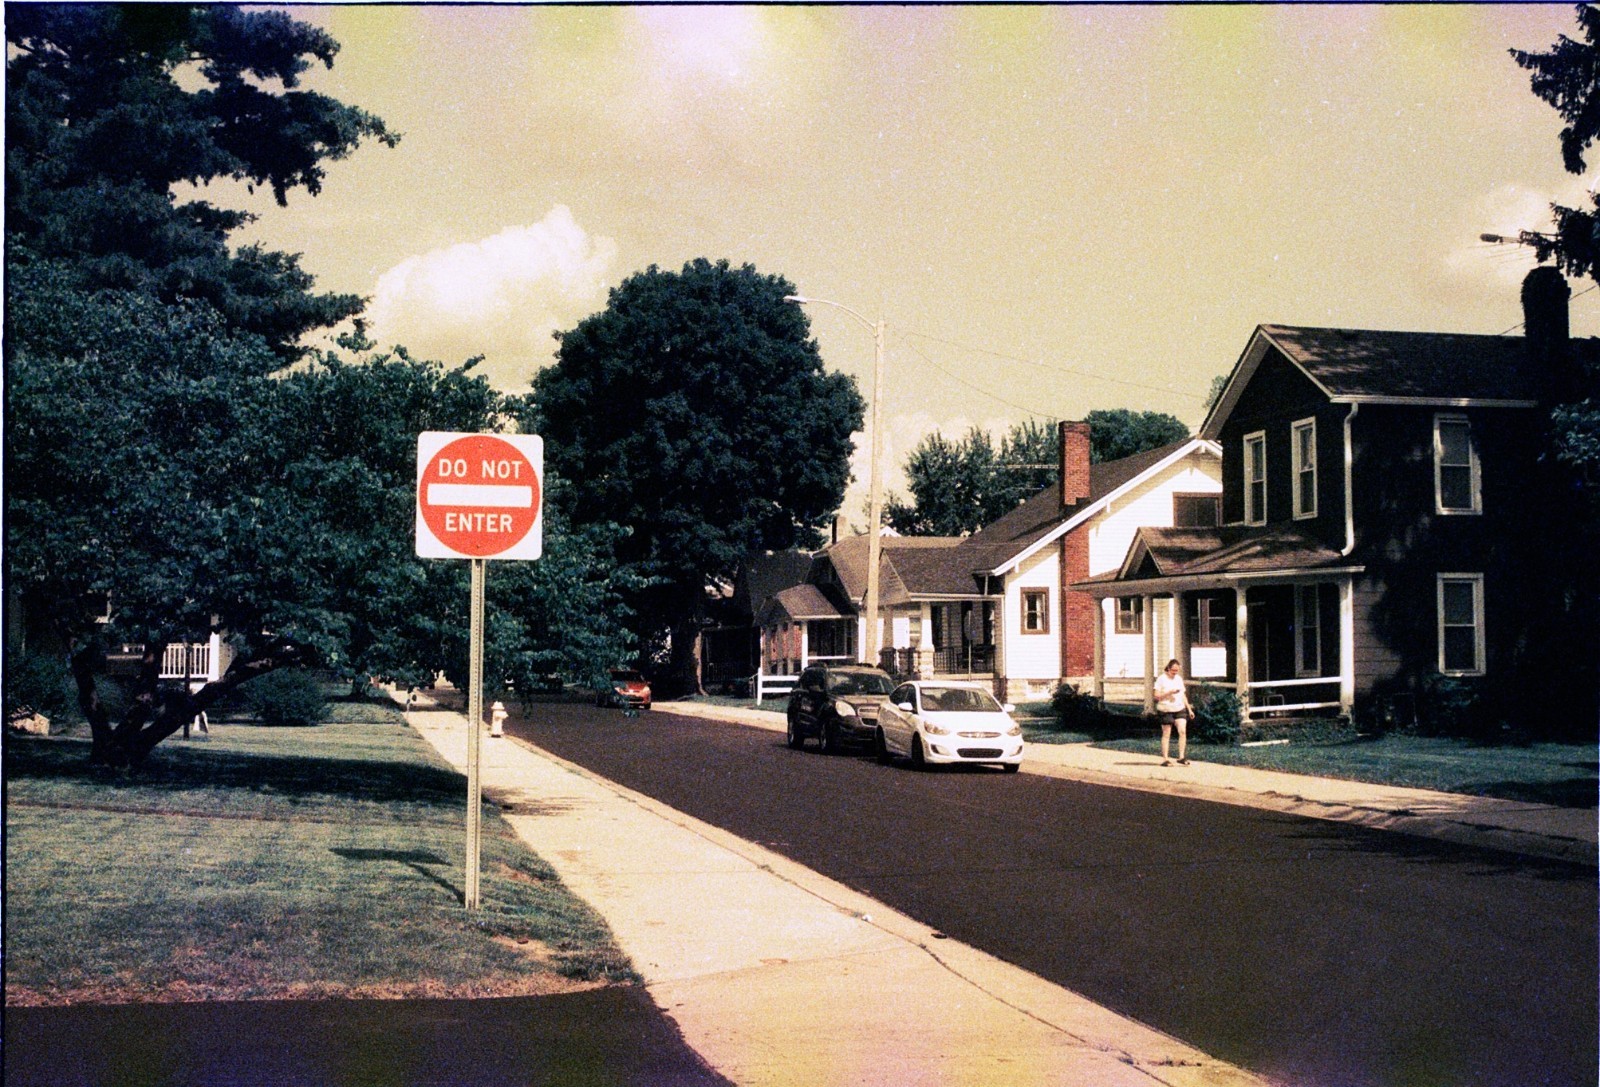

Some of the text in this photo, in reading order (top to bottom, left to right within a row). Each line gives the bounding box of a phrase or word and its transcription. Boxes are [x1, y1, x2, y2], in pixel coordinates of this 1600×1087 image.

[438, 458, 523, 479] DO NOT
[445, 512, 513, 533] ENTER
